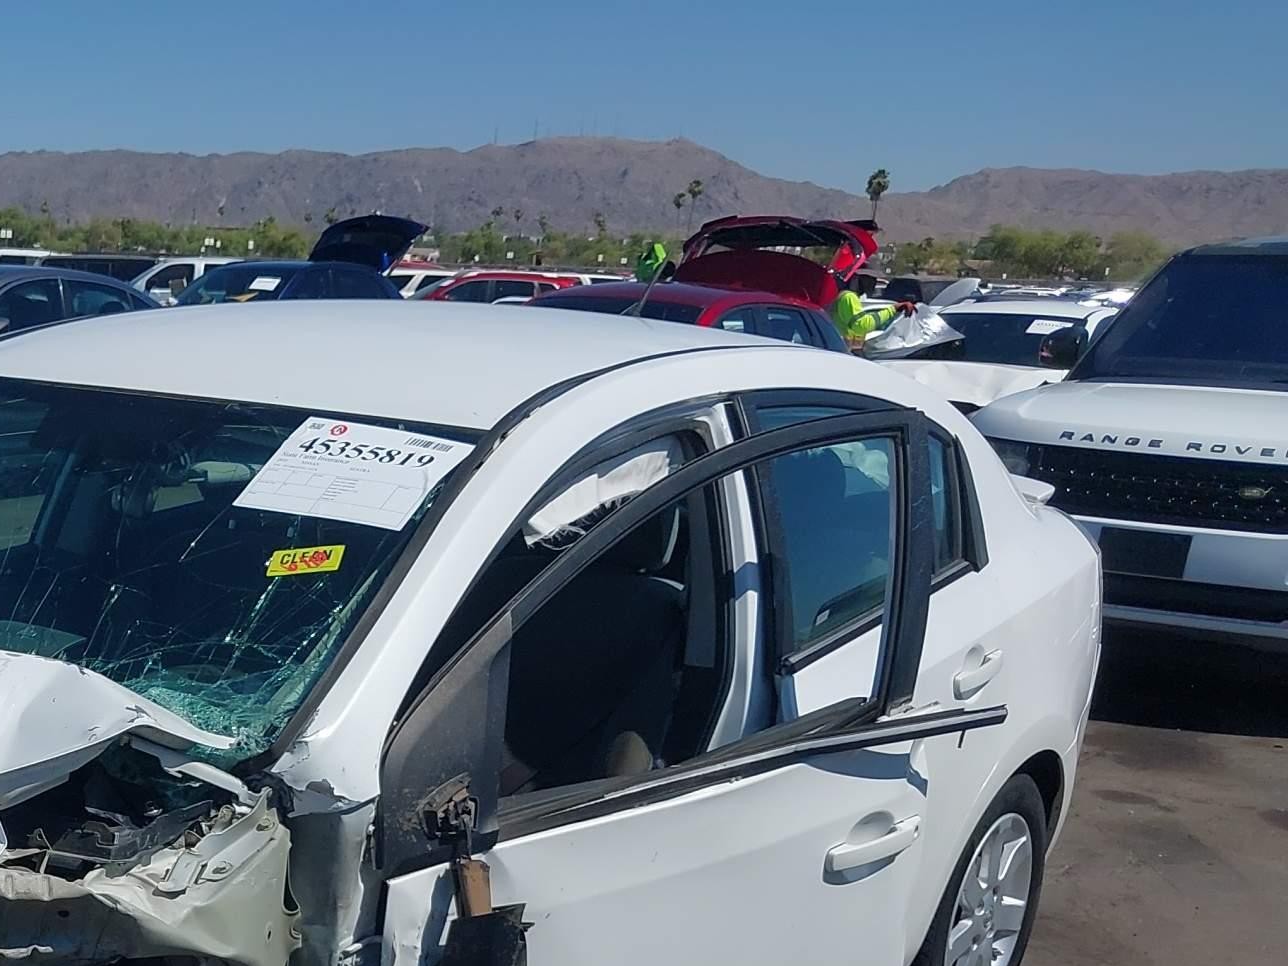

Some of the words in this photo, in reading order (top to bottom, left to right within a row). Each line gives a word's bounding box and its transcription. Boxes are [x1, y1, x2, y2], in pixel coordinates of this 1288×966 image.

[298, 437, 435, 468] 45355819
[1059, 431, 1164, 449] RANGE
[1185, 441, 1288, 458] ROVE
